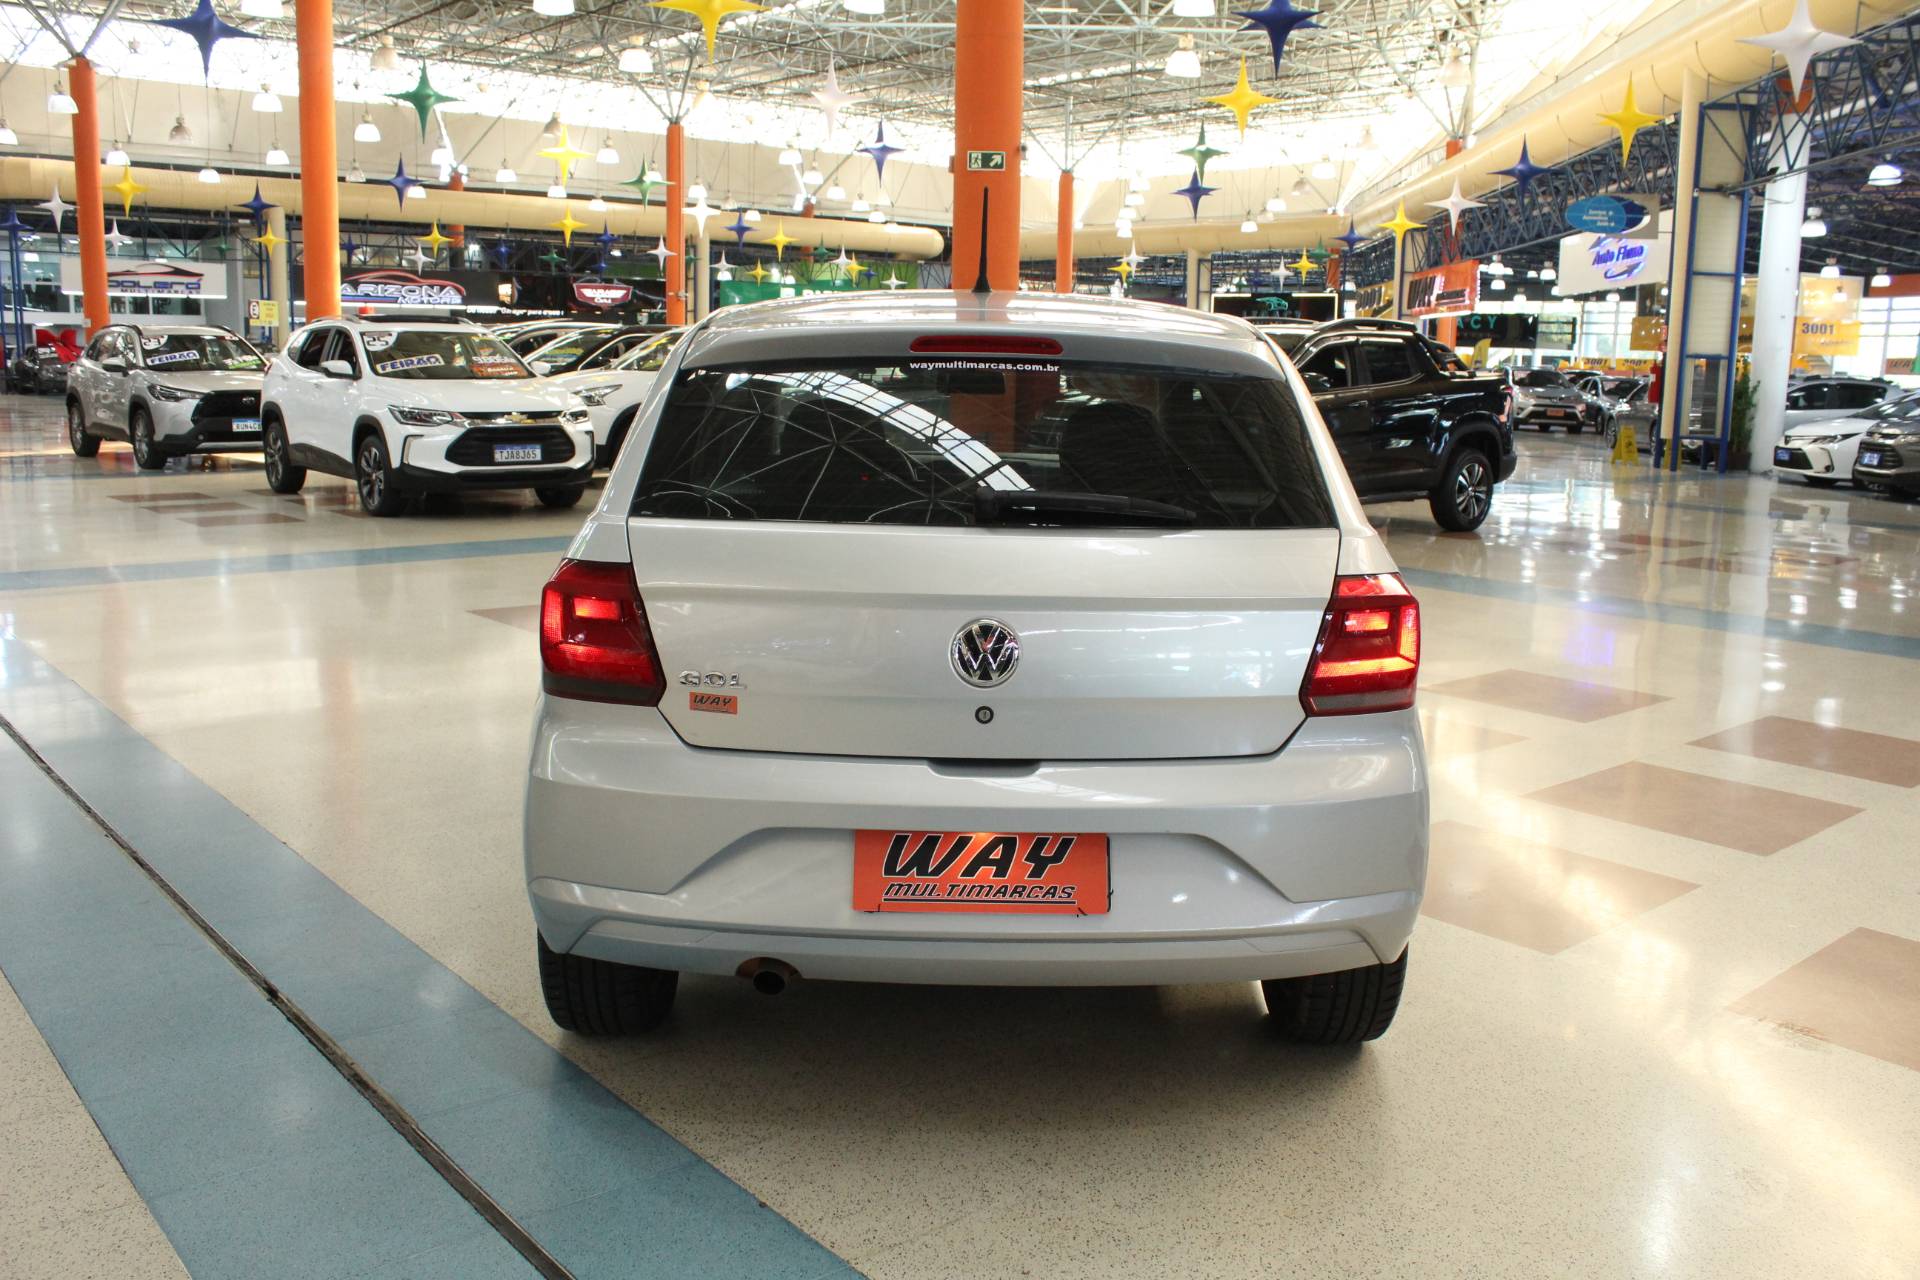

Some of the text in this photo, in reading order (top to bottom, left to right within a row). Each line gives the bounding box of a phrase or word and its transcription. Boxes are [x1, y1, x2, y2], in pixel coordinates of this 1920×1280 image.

[341, 283, 462, 297] ARIZONA
[1801, 322, 1834, 335] 3001
[910, 360, 1060, 372] waymultimarcas.com.br
[679, 671, 747, 688] GOL
[694, 694, 733, 706] WAY
[882, 833, 1077, 880] WAY
[883, 881, 1077, 899] MULTIMARCAS
